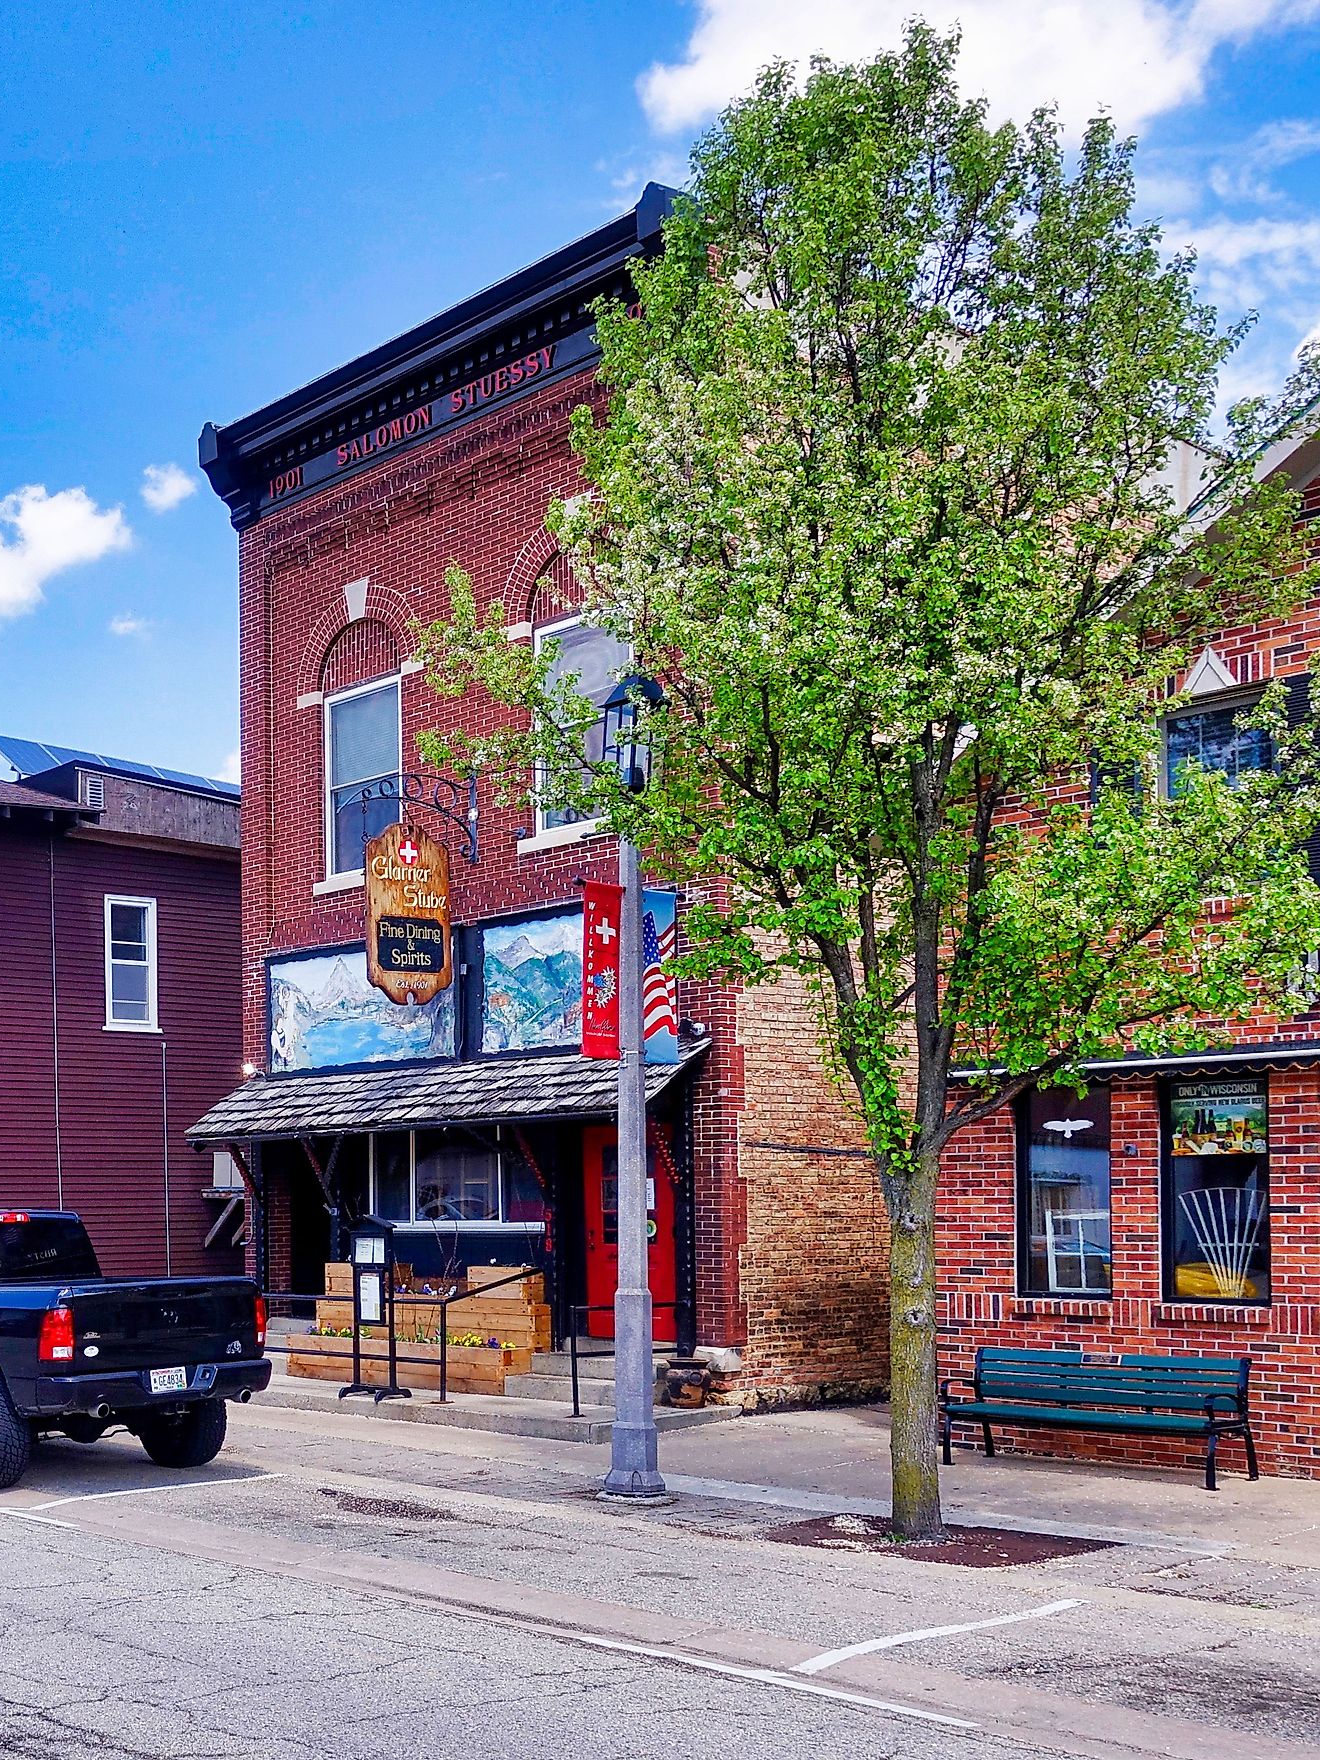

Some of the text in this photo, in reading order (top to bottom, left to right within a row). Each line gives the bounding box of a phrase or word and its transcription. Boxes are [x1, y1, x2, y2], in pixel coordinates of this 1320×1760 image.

[269, 345, 556, 498] 1901 SALOMON STUESSY
[372, 855, 432, 883] Glarner
[403, 884, 447, 909] Stube
[379, 921, 441, 944] Fine Dining
[407, 938, 416, 951] &
[391, 948, 432, 967] Spirits
[586, 901, 596, 1020] WILLKOMMEN
[1178, 1086, 1198, 1096] ONLY
[1210, 1083, 1257, 1095] WISCONSIN
